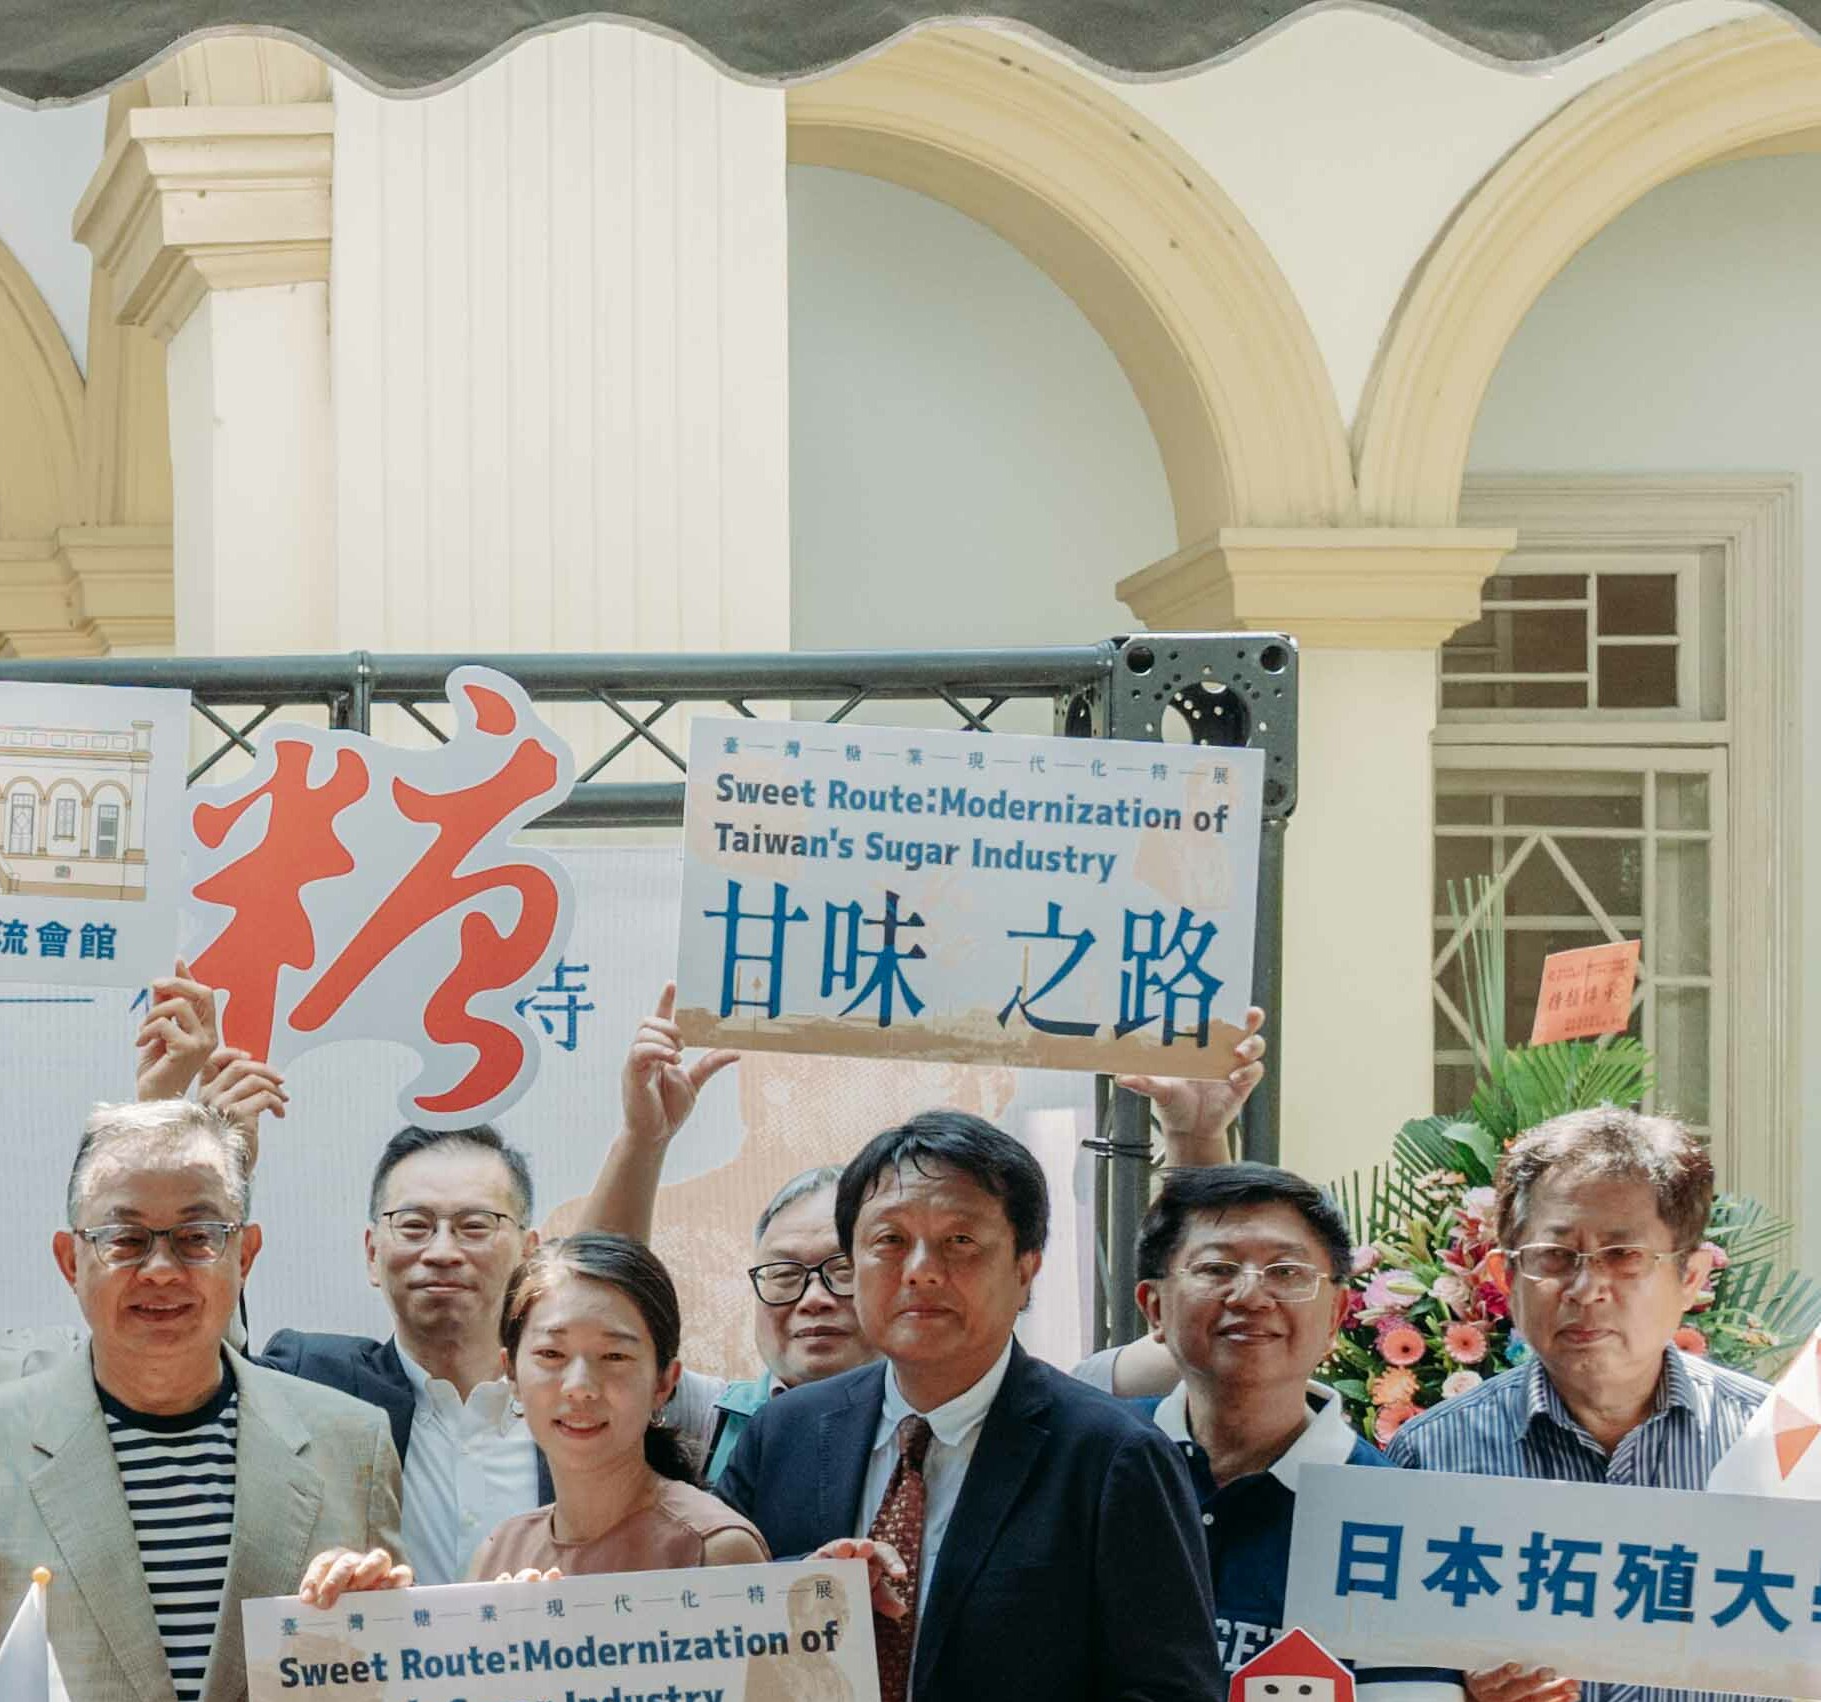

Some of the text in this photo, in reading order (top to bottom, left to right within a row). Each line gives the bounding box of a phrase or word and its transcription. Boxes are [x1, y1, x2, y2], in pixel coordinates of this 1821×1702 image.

[716, 773, 816, 808] Sweet
[1193, 804, 1229, 833] of
[714, 822, 1117, 882] Taiwan's Sugar Industry
[703, 879, 1224, 1048] 甘味 之路
[1334, 1520, 1821, 1635] 日本拓殖大
[279, 1651, 388, 1689] Sweet
[801, 1620, 839, 1654] of
